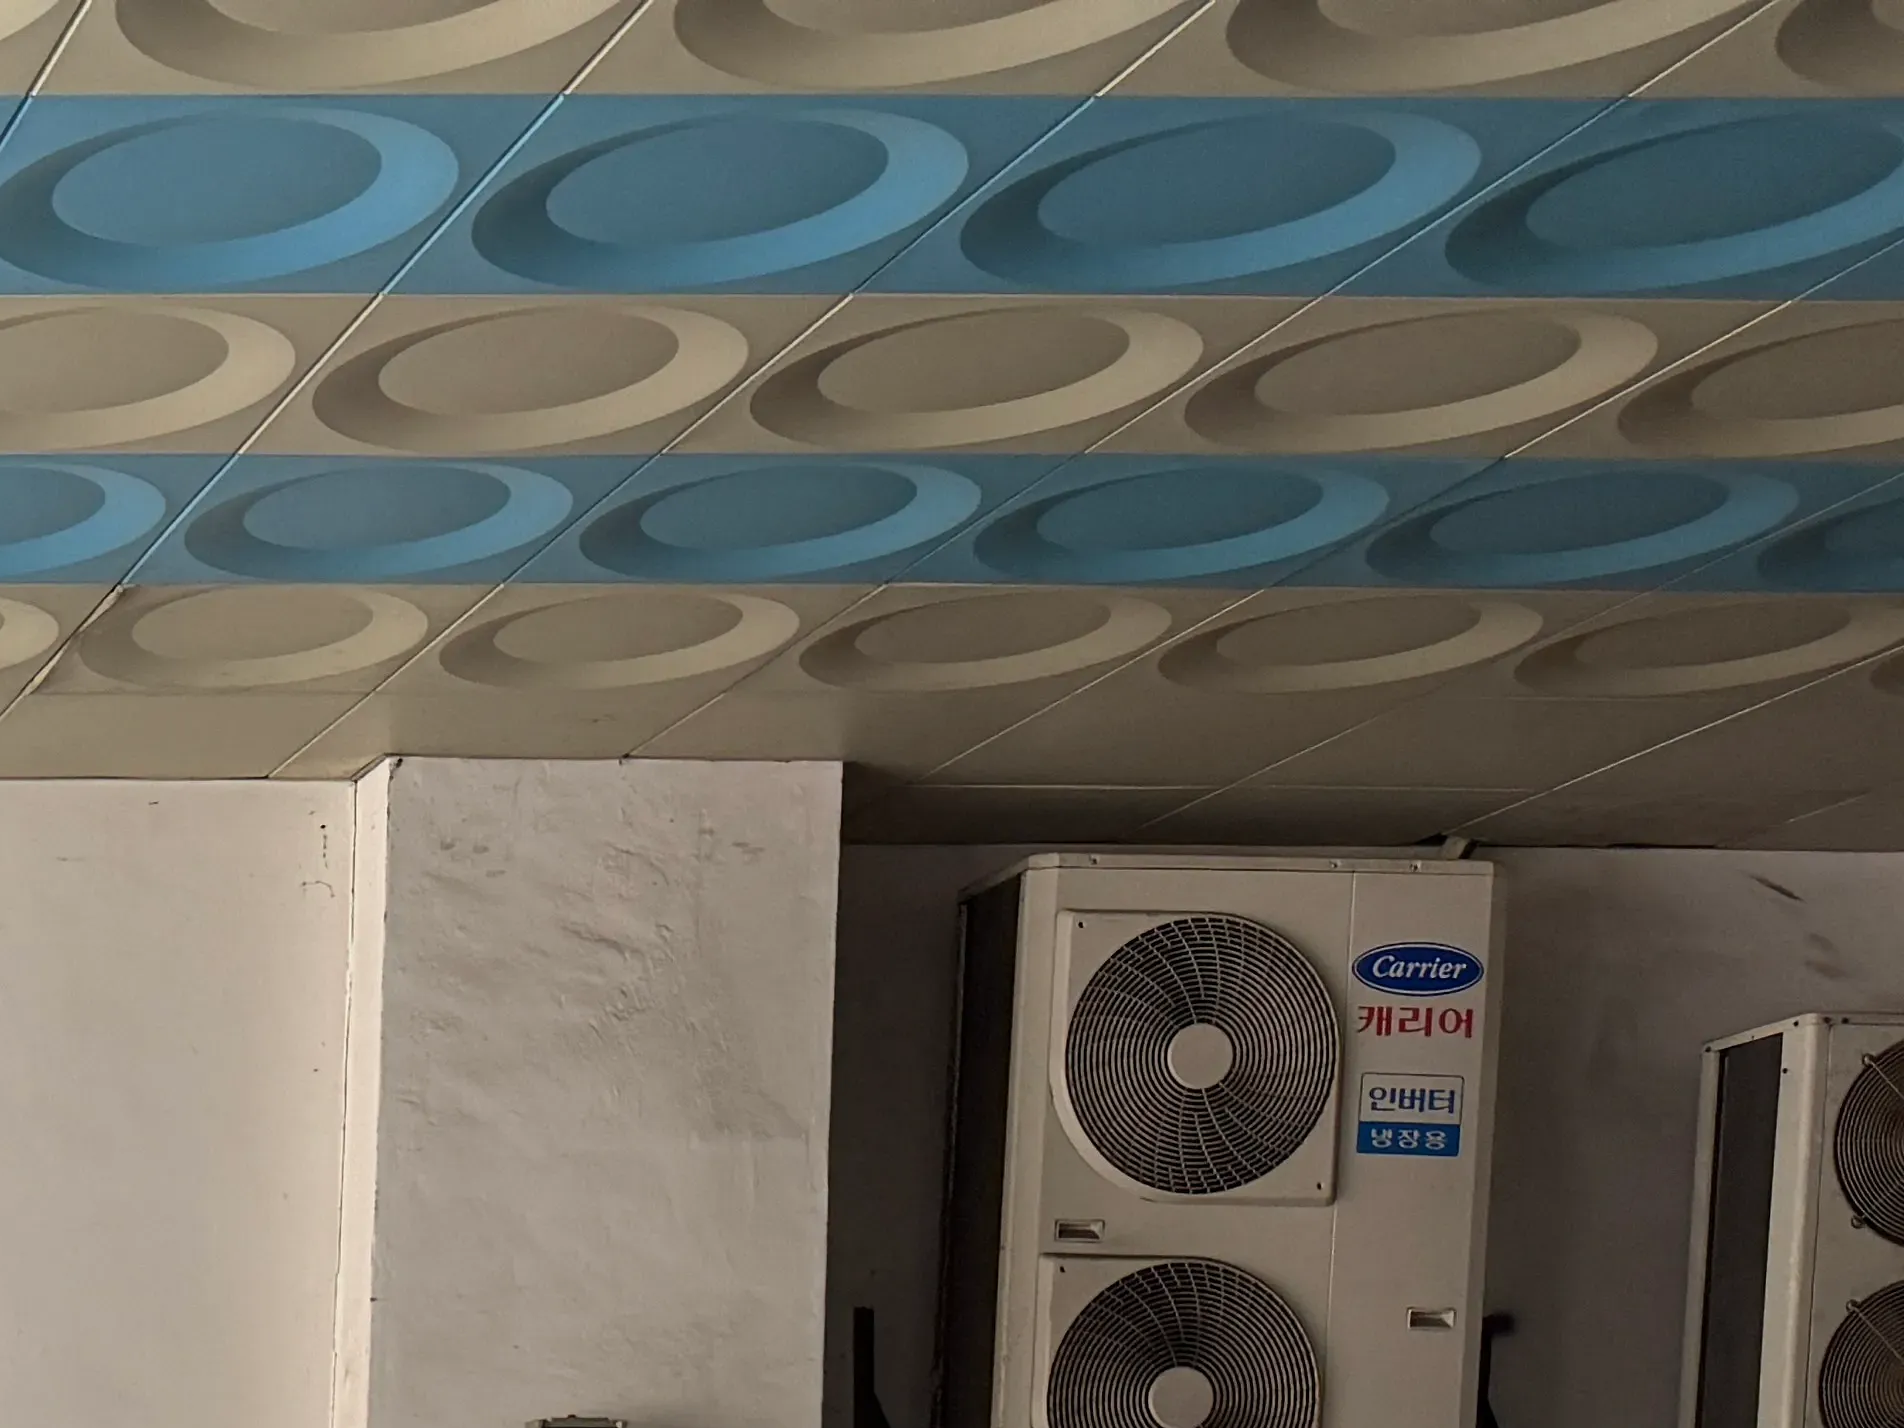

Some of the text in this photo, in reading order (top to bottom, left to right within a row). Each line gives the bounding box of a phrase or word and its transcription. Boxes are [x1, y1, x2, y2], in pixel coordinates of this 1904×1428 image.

[1372, 955, 1468, 979] Carrier
[1357, 1005, 1474, 1039] 캐리어
[1368, 1086, 1456, 1114] 인버터
[1369, 1127, 1448, 1151] 냉장용
